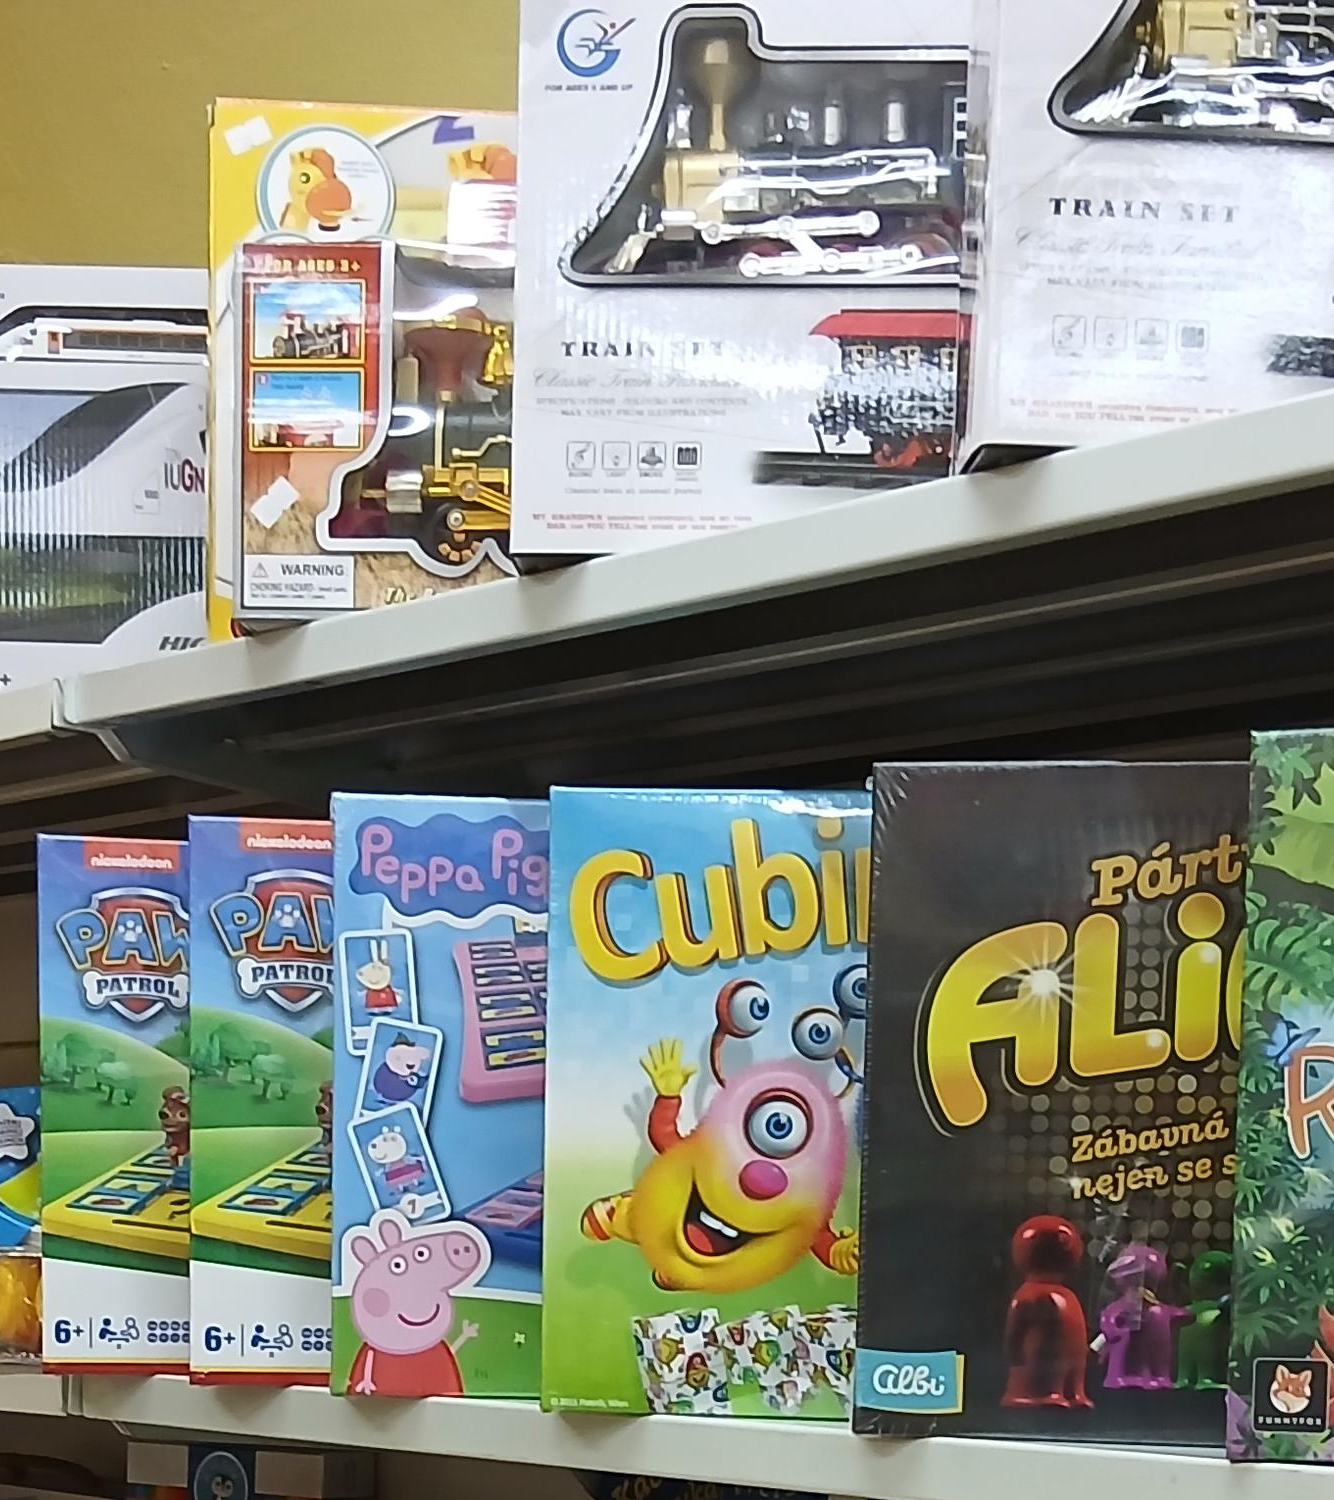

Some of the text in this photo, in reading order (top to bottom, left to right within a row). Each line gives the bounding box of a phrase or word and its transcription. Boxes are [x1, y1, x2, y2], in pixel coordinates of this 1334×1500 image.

[1049, 197, 1240, 223] TRAIN SET
[246, 832, 332, 850] nickelodeon
[90, 854, 173, 871] nickelodeon
[360, 824, 485, 905] Peppa
[1091, 832, 1247, 906] Párt
[95, 974, 181, 998] PATROL
[925, 891, 1244, 1128] ALi
[1071, 1110, 1230, 1164] Zábavná
[1072, 1164, 1169, 1203] nejen
[1176, 1159, 1214, 1183] se
[53, 1320, 85, 1346] 6+
[204, 1325, 236, 1353] 6+
